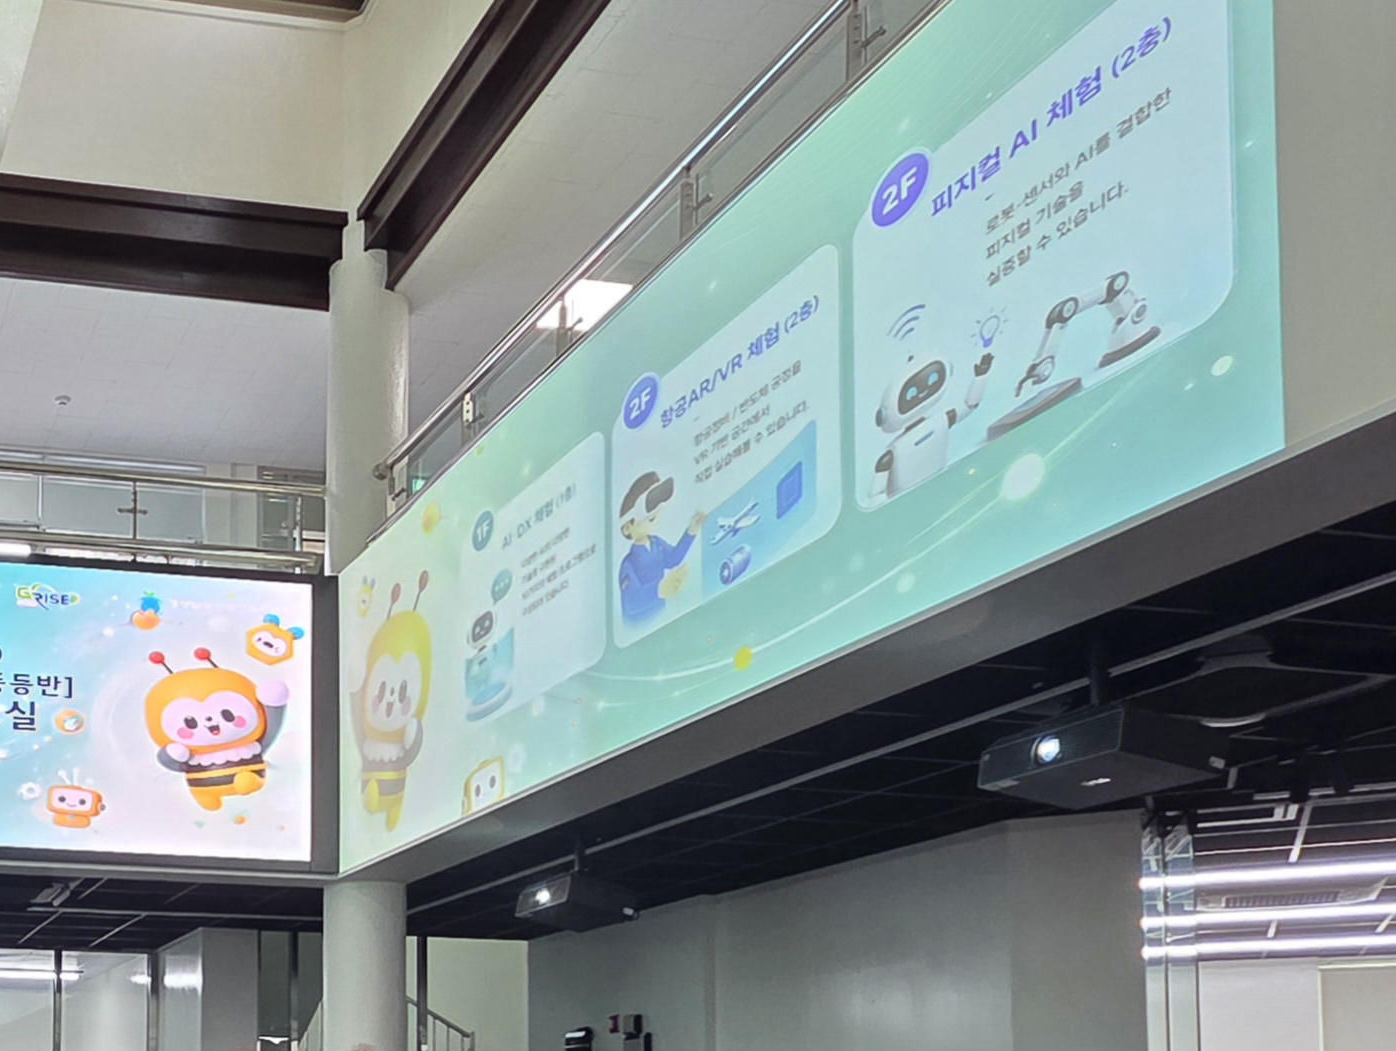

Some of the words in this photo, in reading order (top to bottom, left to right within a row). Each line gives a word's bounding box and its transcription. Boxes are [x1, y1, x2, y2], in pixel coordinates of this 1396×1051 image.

[931, 145, 1001, 217] 피지컬
[1009, 119, 1038, 159] AI
[1046, 66, 1102, 127] 체험
[1111, 17, 1172, 79] (2층)
[1074, 131, 1110, 170] AI를
[1116, 87, 1172, 139] 결합한
[882, 166, 917, 216] 2F
[986, 218, 1031, 259] 피지컬
[1036, 181, 1084, 224] 기술을
[1036, 234, 1052, 250] 수
[1057, 180, 1129, 240] 있습니다.
[660, 353, 743, 429] 항공AR/VR
[747, 321, 780, 360] 체험
[784, 294, 819, 334] (2층)
[630, 387, 651, 421] 2F
[693, 450, 708, 465] VR
[477, 520, 491, 542] 1F
